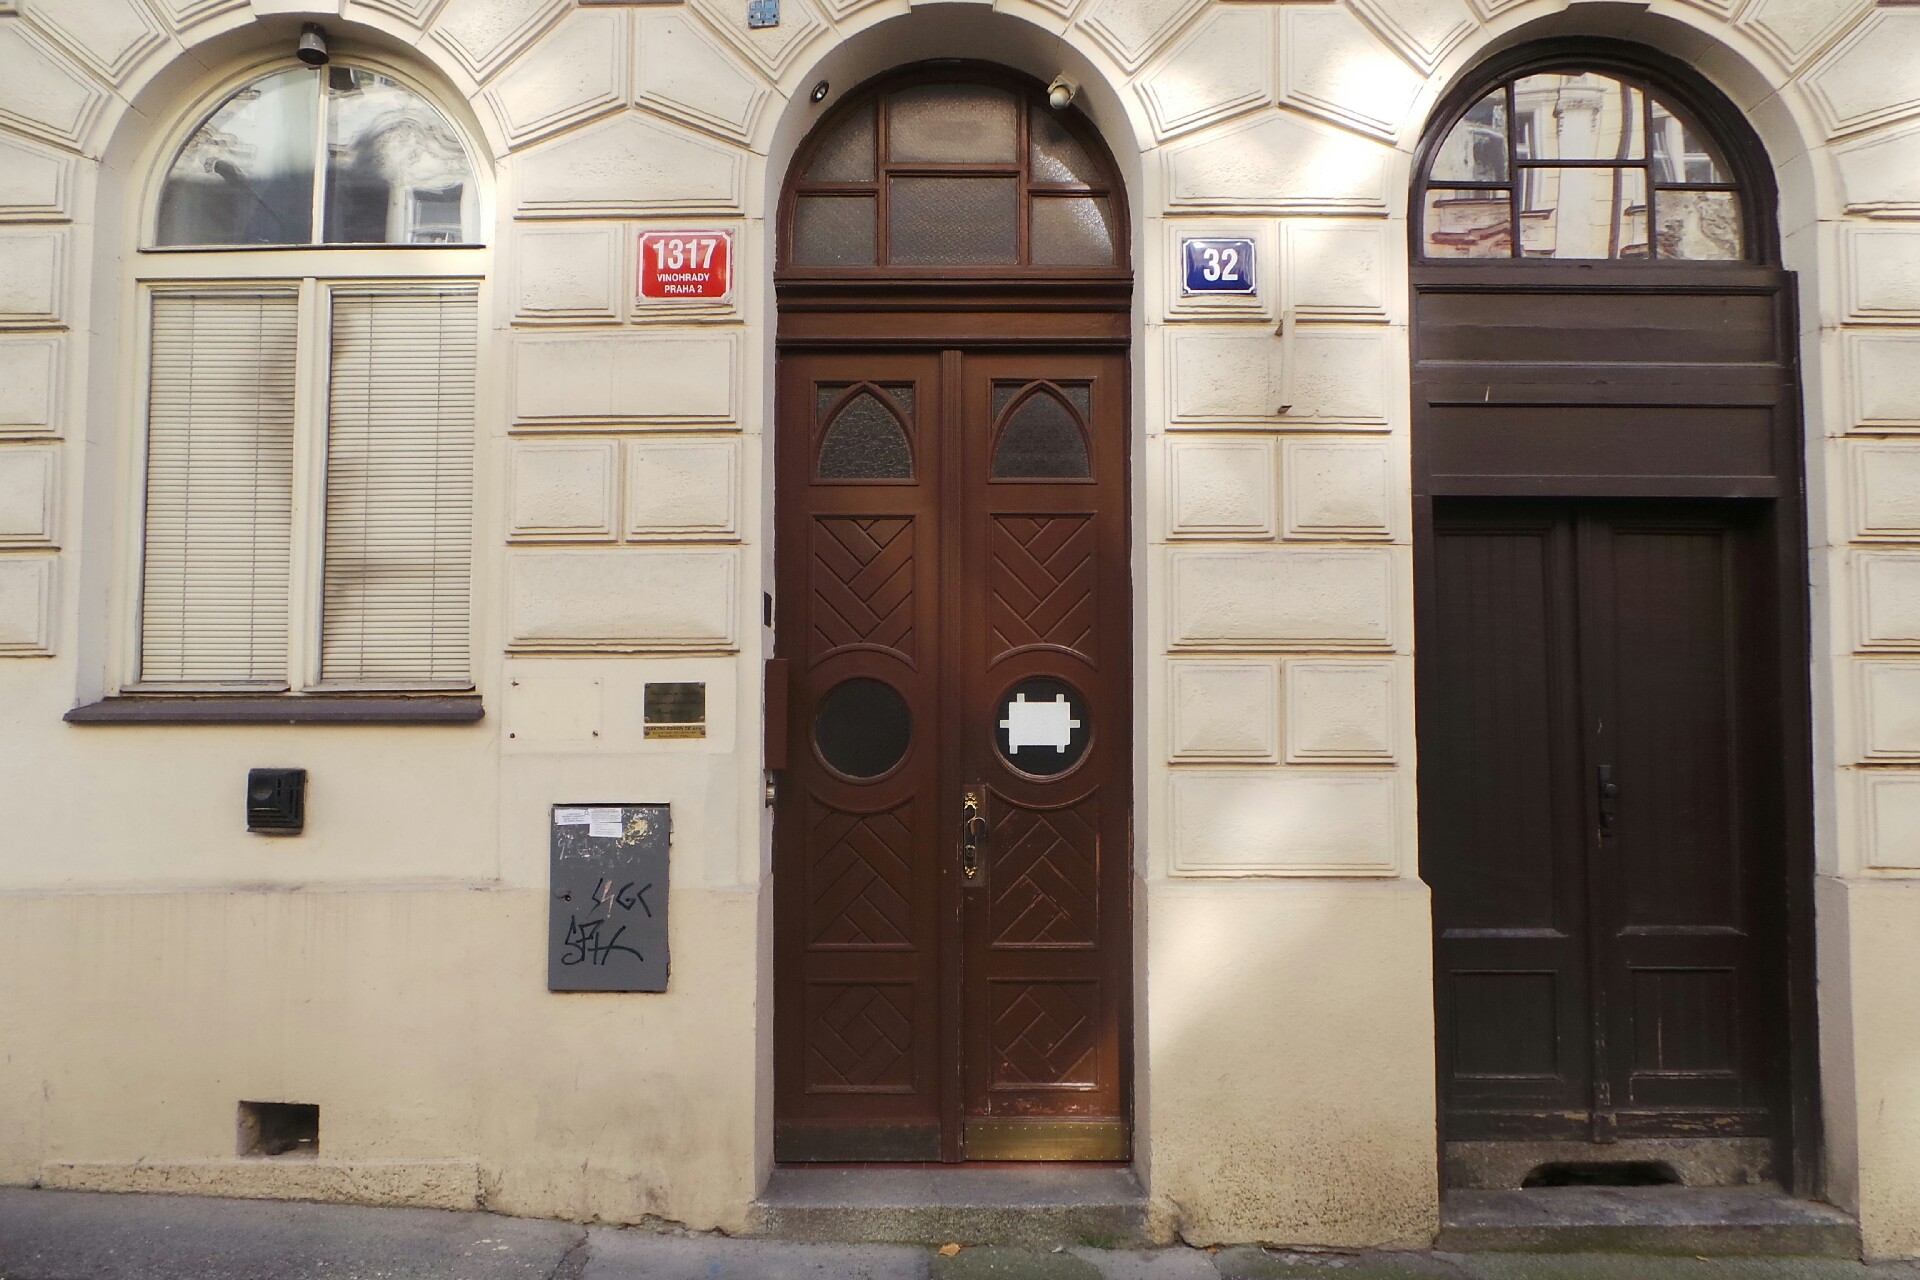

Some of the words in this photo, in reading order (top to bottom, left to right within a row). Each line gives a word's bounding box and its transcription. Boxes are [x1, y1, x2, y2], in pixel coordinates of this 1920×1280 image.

[653, 239, 717, 269] 1317
[1203, 248, 1238, 281] 32
[657, 273, 710, 282] VINOHRADY
[664, 285, 695, 293] PRAHA
[697, 285, 703, 293] 2
